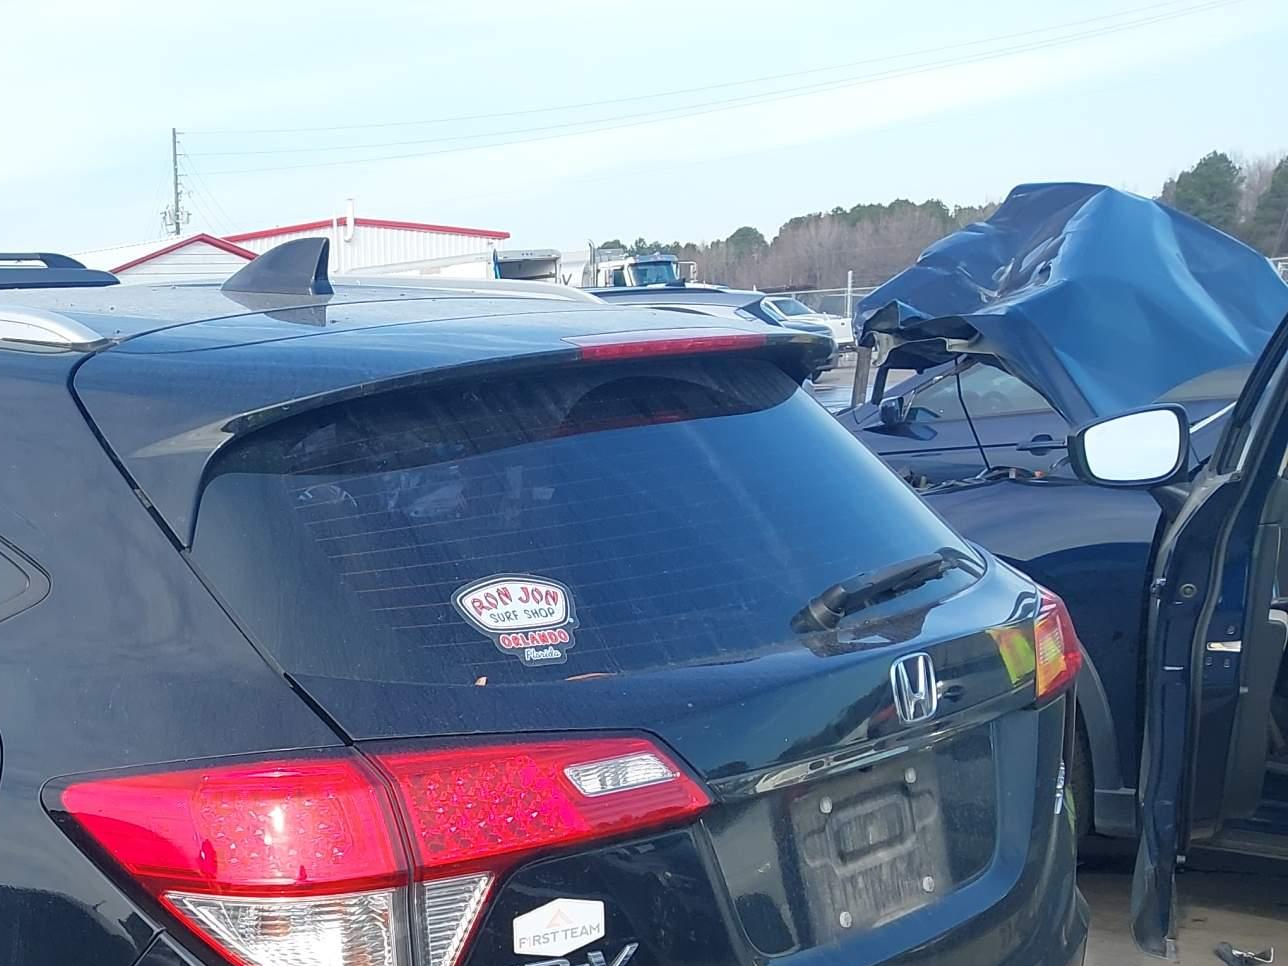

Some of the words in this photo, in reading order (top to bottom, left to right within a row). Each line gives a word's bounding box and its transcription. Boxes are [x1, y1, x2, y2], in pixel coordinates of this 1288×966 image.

[471, 586, 512, 616] RON
[518, 586, 559, 607] JON
[489, 611, 519, 624] SURF
[524, 607, 555, 619] SHOP
[499, 629, 570, 649] ORLANDO
[524, 646, 561, 661] Florida
[561, 922, 600, 941] TEAM
